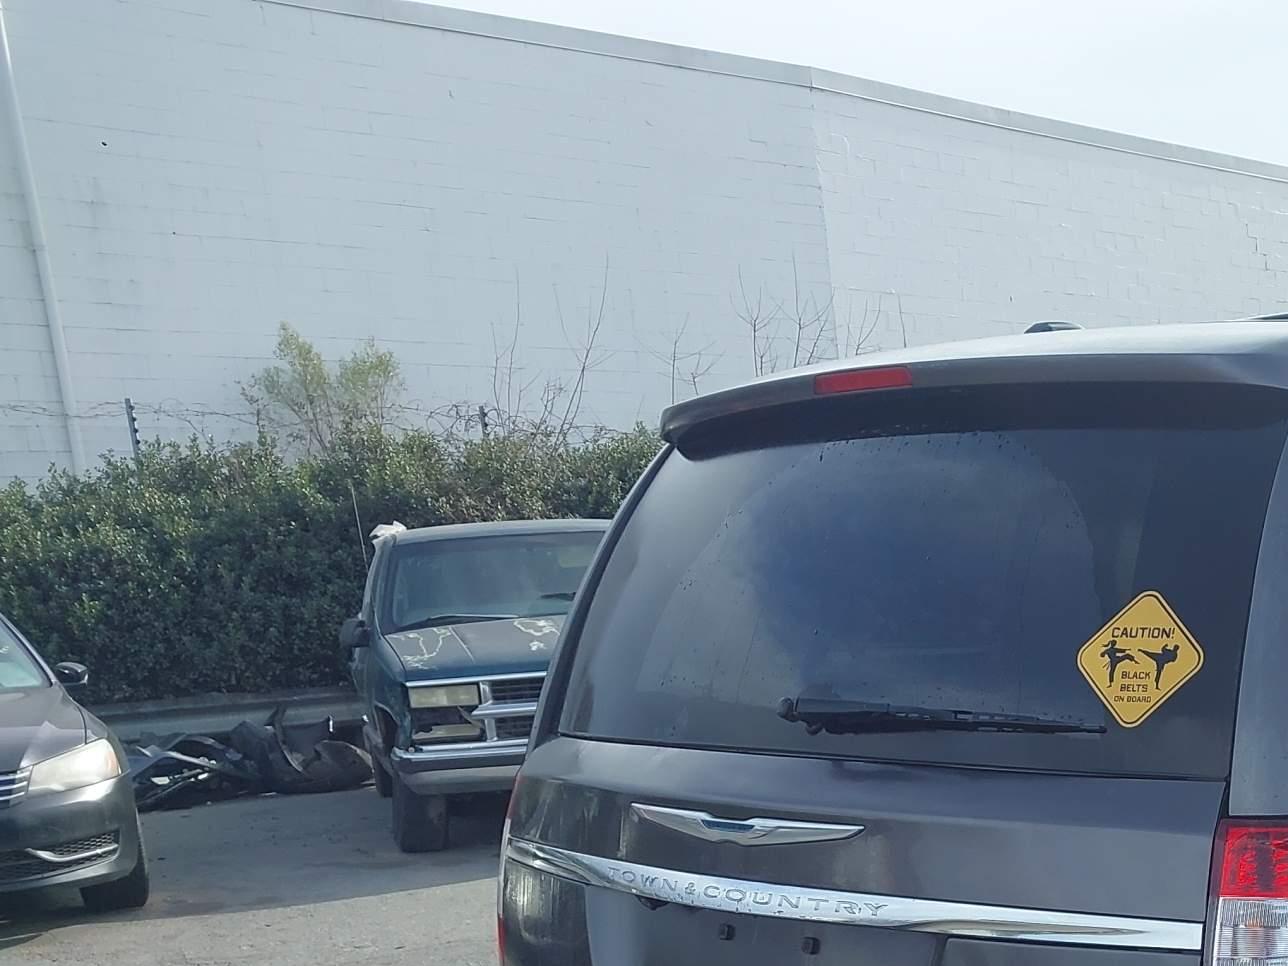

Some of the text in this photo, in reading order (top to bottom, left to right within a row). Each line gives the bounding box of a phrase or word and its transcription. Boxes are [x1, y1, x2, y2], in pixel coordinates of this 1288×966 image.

[1111, 627, 1175, 639] CAUTION!
[1121, 671, 1151, 680] BLACK
[1120, 684, 1148, 693] BELTS
[1126, 696, 1152, 704] BOARD
